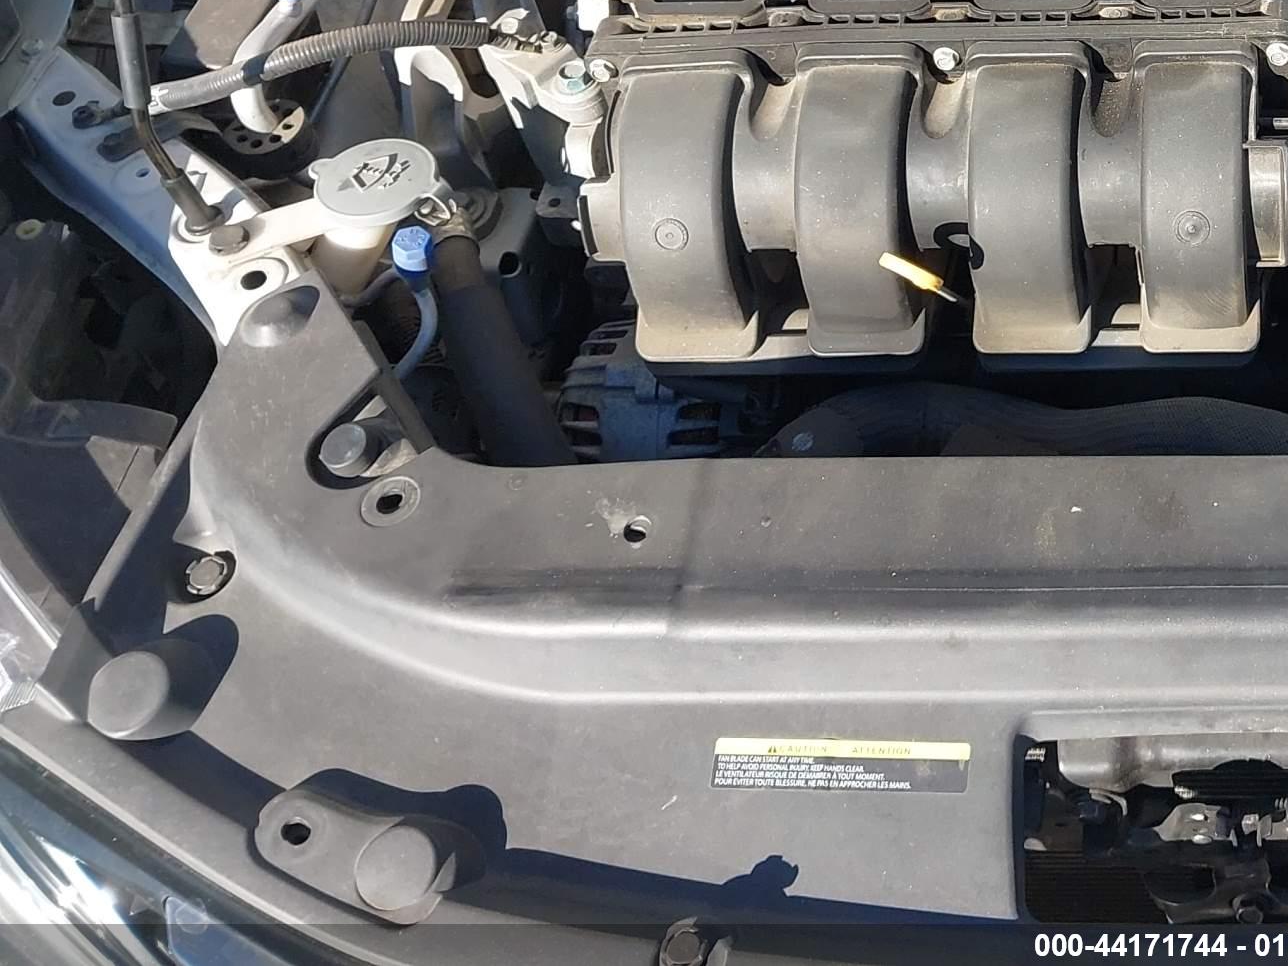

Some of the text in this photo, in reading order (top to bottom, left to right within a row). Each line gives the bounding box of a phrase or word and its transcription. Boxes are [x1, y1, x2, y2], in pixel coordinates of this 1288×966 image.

[852, 746, 911, 754] ATTENTION
[748, 755, 762, 763] CAN
[759, 763, 788, 771] PERSONAL
[810, 764, 824, 772] KEEP
[765, 771, 787, 779] RISQUE
[838, 780, 877, 788] APPROCHER
